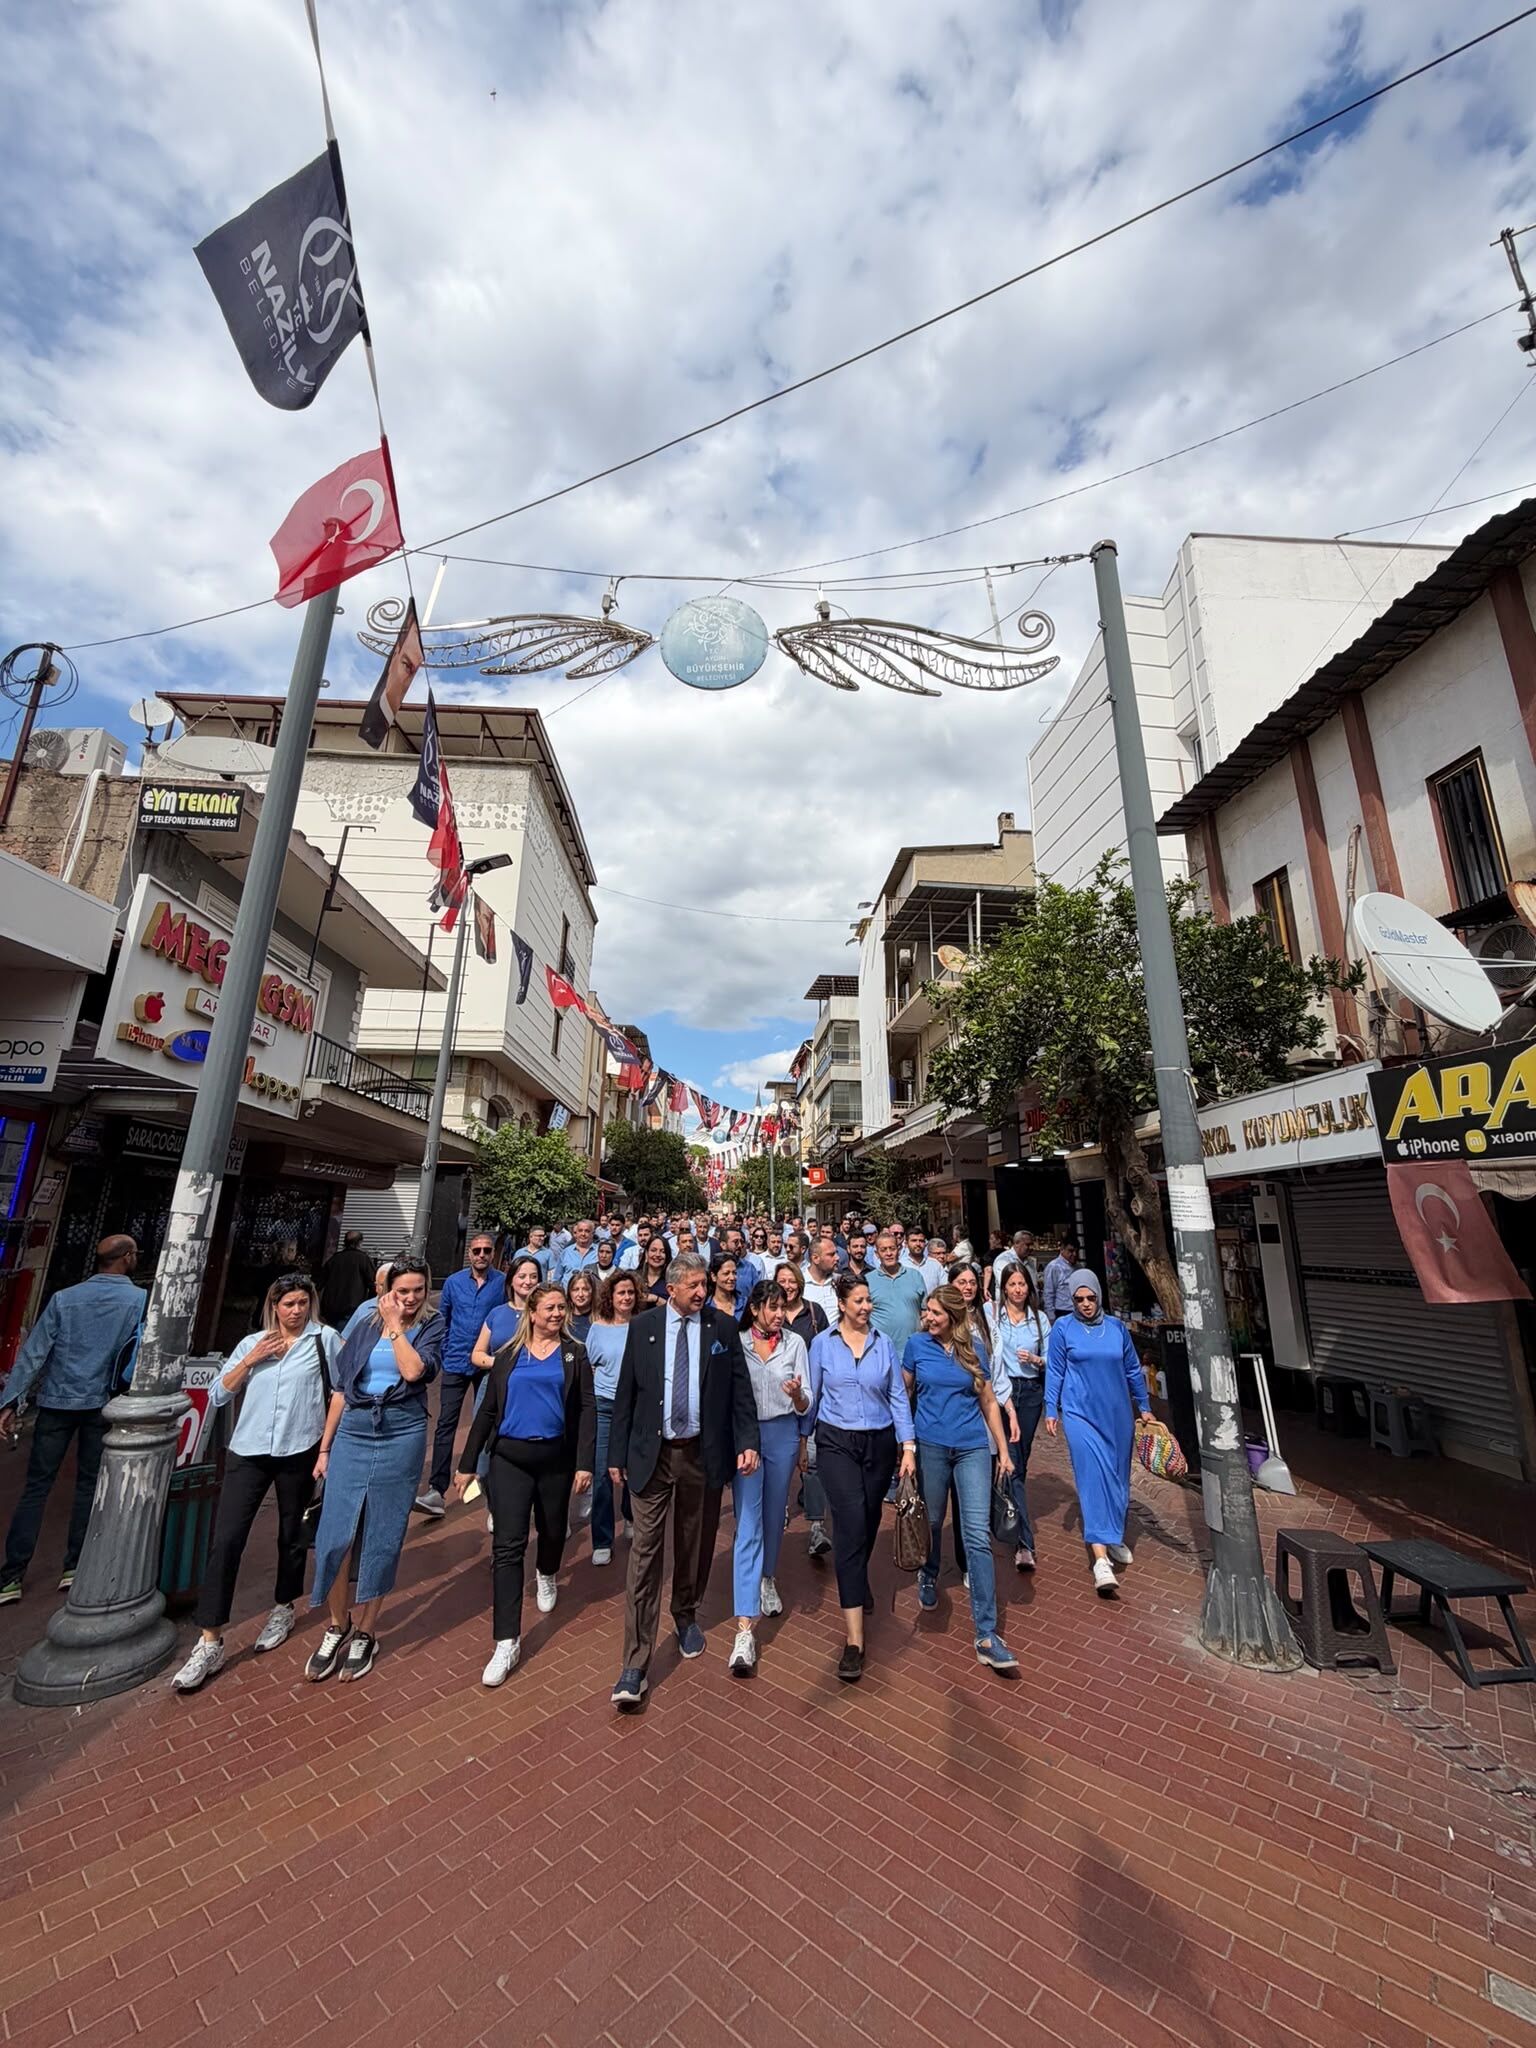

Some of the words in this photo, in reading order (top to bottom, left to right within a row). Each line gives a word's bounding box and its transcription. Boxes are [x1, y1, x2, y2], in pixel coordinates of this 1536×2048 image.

[251, 240, 316, 386] NAZİLL
[686, 663, 745, 674] BÜYÜKŞEHİR
[141, 815, 153, 823] CEP
[154, 816, 187, 825] TELEFONU
[188, 816, 211, 826] TEKNİK
[212, 818, 237, 828] SERVİSİ
[146, 902, 231, 987] MEG
[260, 974, 314, 1034] GSM
[128, 1024, 165, 1052] iPhone
[1242, 1092, 1375, 1150] KUYUMCULUK
[1409, 1138, 1460, 1156] iPhone
[190, 1371, 214, 1385] GSM
